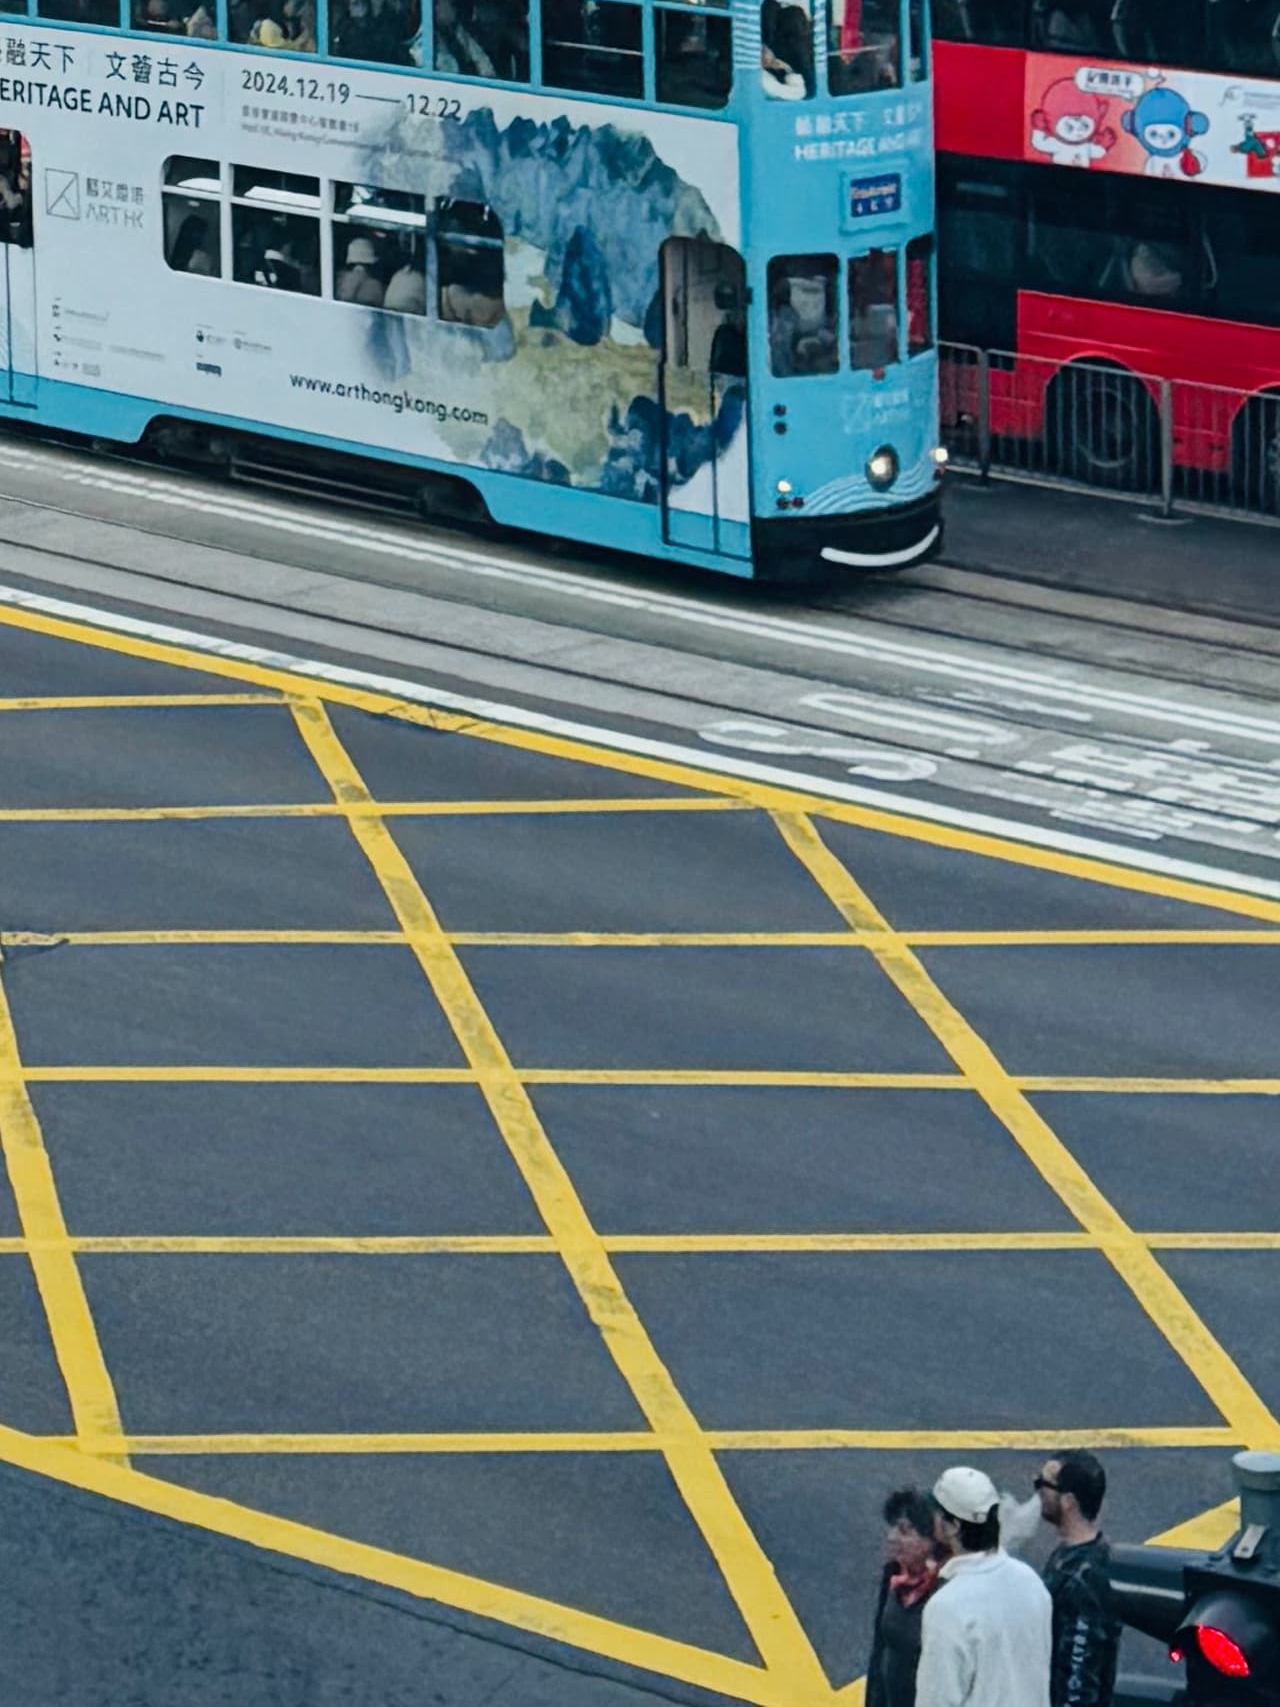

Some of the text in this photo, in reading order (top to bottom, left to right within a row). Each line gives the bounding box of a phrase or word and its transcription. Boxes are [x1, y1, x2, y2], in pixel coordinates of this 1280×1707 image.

[98, 92, 151, 120] AND
[157, 100, 206, 128] ART
[241, 70, 462, 120] 2024.12.19 12.22
[290, 373, 489, 426] www.arthongkong.com
